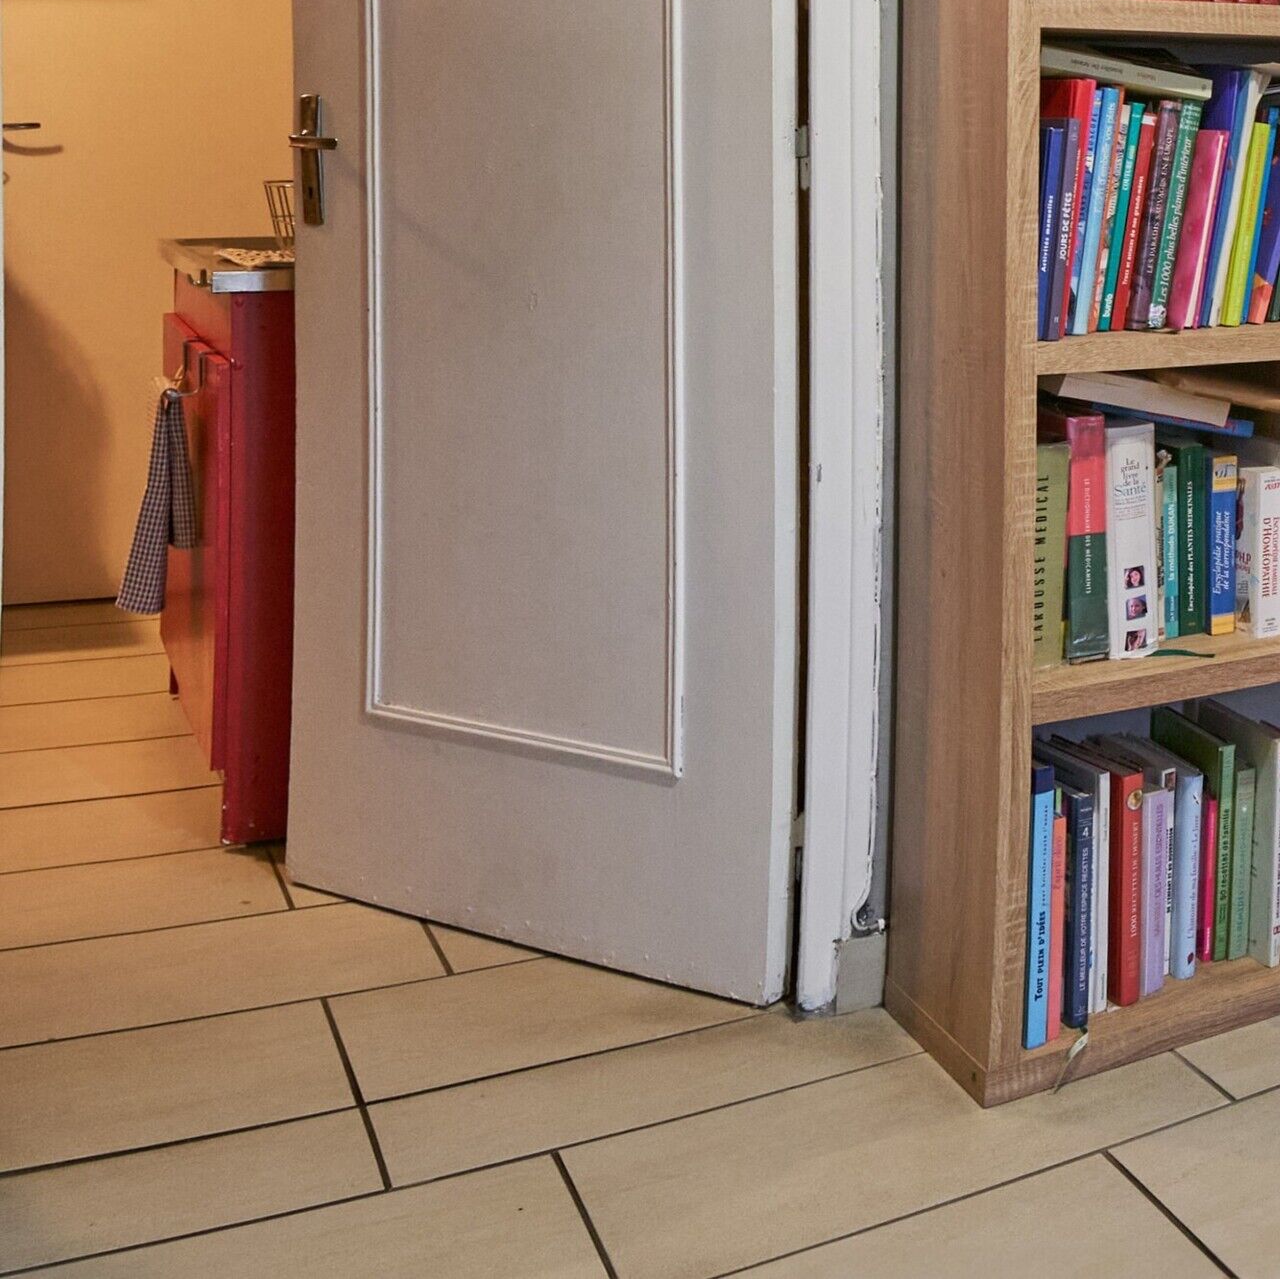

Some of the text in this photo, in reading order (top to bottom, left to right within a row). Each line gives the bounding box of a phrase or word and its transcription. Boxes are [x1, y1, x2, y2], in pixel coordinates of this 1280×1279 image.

[1161, 128, 1173, 162] EUROPE
[1161, 163, 1168, 175] EN
[1178, 136, 1193, 182] d'intérieur
[1172, 184, 1187, 214] plantes
[1038, 196, 1055, 272] Activités manuelles
[1056, 191, 1073, 259] JOURS DE FÊTES
[1129, 229, 1136, 237] de
[1130, 217, 1138, 228] nos
[1167, 214, 1180, 240] belles
[1150, 222, 1160, 256] PARADIS
[1165, 240, 1177, 259] plus
[1121, 268, 1130, 285] Trucs
[1146, 258, 1155, 273] LES
[1161, 261, 1172, 286] 1000
[1101, 292, 1114, 317] burda
[1158, 286, 1169, 302] Les
[1121, 462, 1139, 473] grand
[1114, 481, 1146, 497] Santé
[1166, 503, 1176, 580] la méthode DUKAN
[1211, 510, 1224, 593] Encyclopédie pratique
[1221, 512, 1232, 568] correspondance
[1271, 516, 1280, 562] ENCYCLOPÉDIE
[1221, 579, 1229, 589] de
[1192, 833, 1198, 842] Le
[1219, 808, 1230, 887] recettes de famille
[1050, 859, 1064, 890] Esprit
[1082, 848, 1094, 882] RECETTES
[1189, 849, 1199, 877] famille
[1130, 821, 1140, 937] 1000 RECETTES DE DESSERT
[1190, 877, 1196, 890] ma
[1189, 892, 1196, 900] de
[1036, 911, 1047, 944] D'IDÉES
[1081, 913, 1090, 935] VOTRE
[1186, 901, 1197, 938] L'histoire
[1081, 936, 1088, 945] DE
[1036, 949, 1045, 973] PLEIN
[1078, 945, 1089, 980] MEILLEUR
[1034, 977, 1042, 1001] TOUT
[1079, 981, 1086, 990] LE
